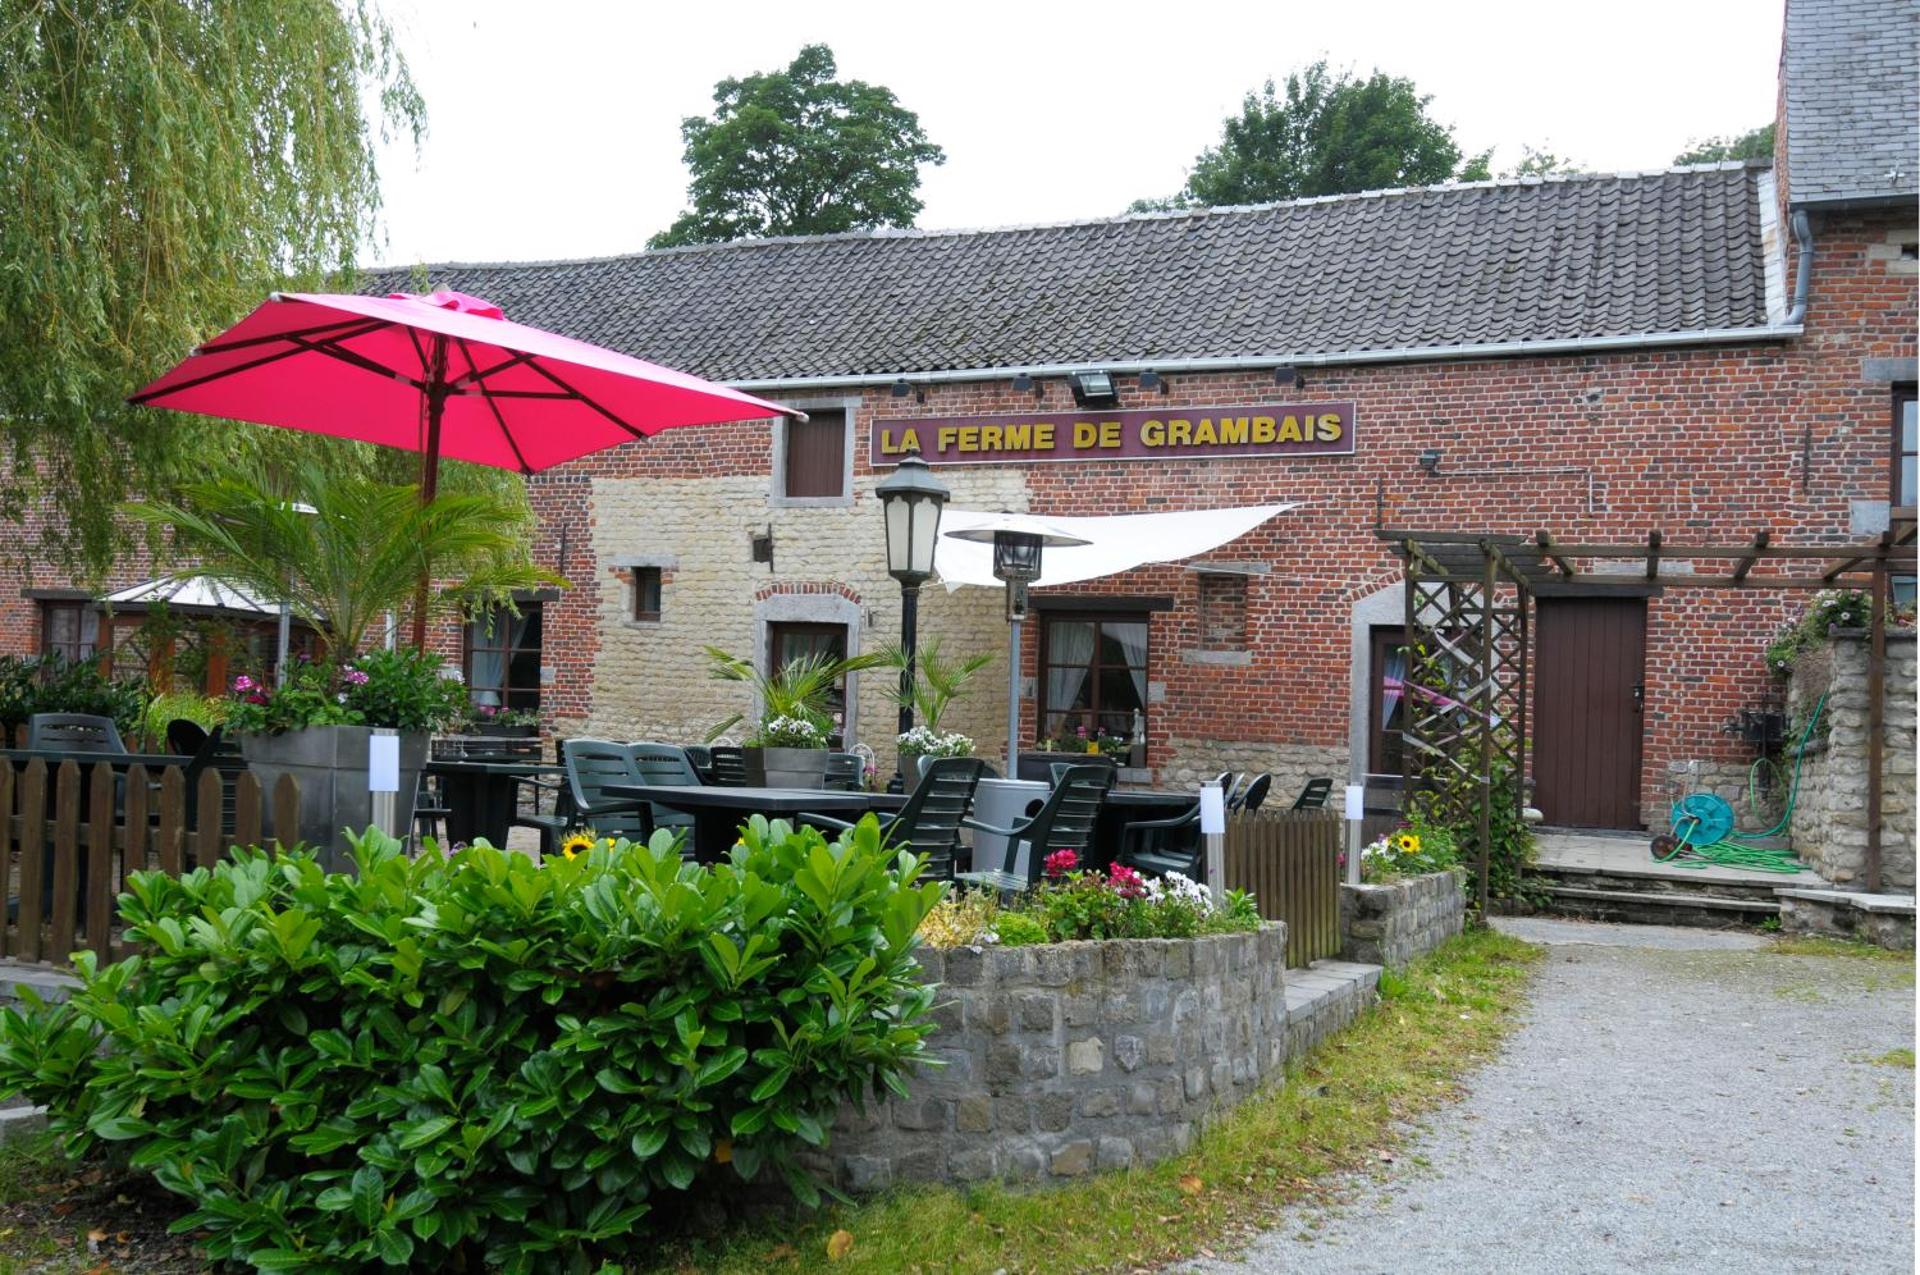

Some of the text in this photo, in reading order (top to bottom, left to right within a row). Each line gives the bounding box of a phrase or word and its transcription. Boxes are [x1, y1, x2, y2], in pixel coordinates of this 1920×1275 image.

[881, 414, 1343, 455] LA FERME DE GRAMBAIS
